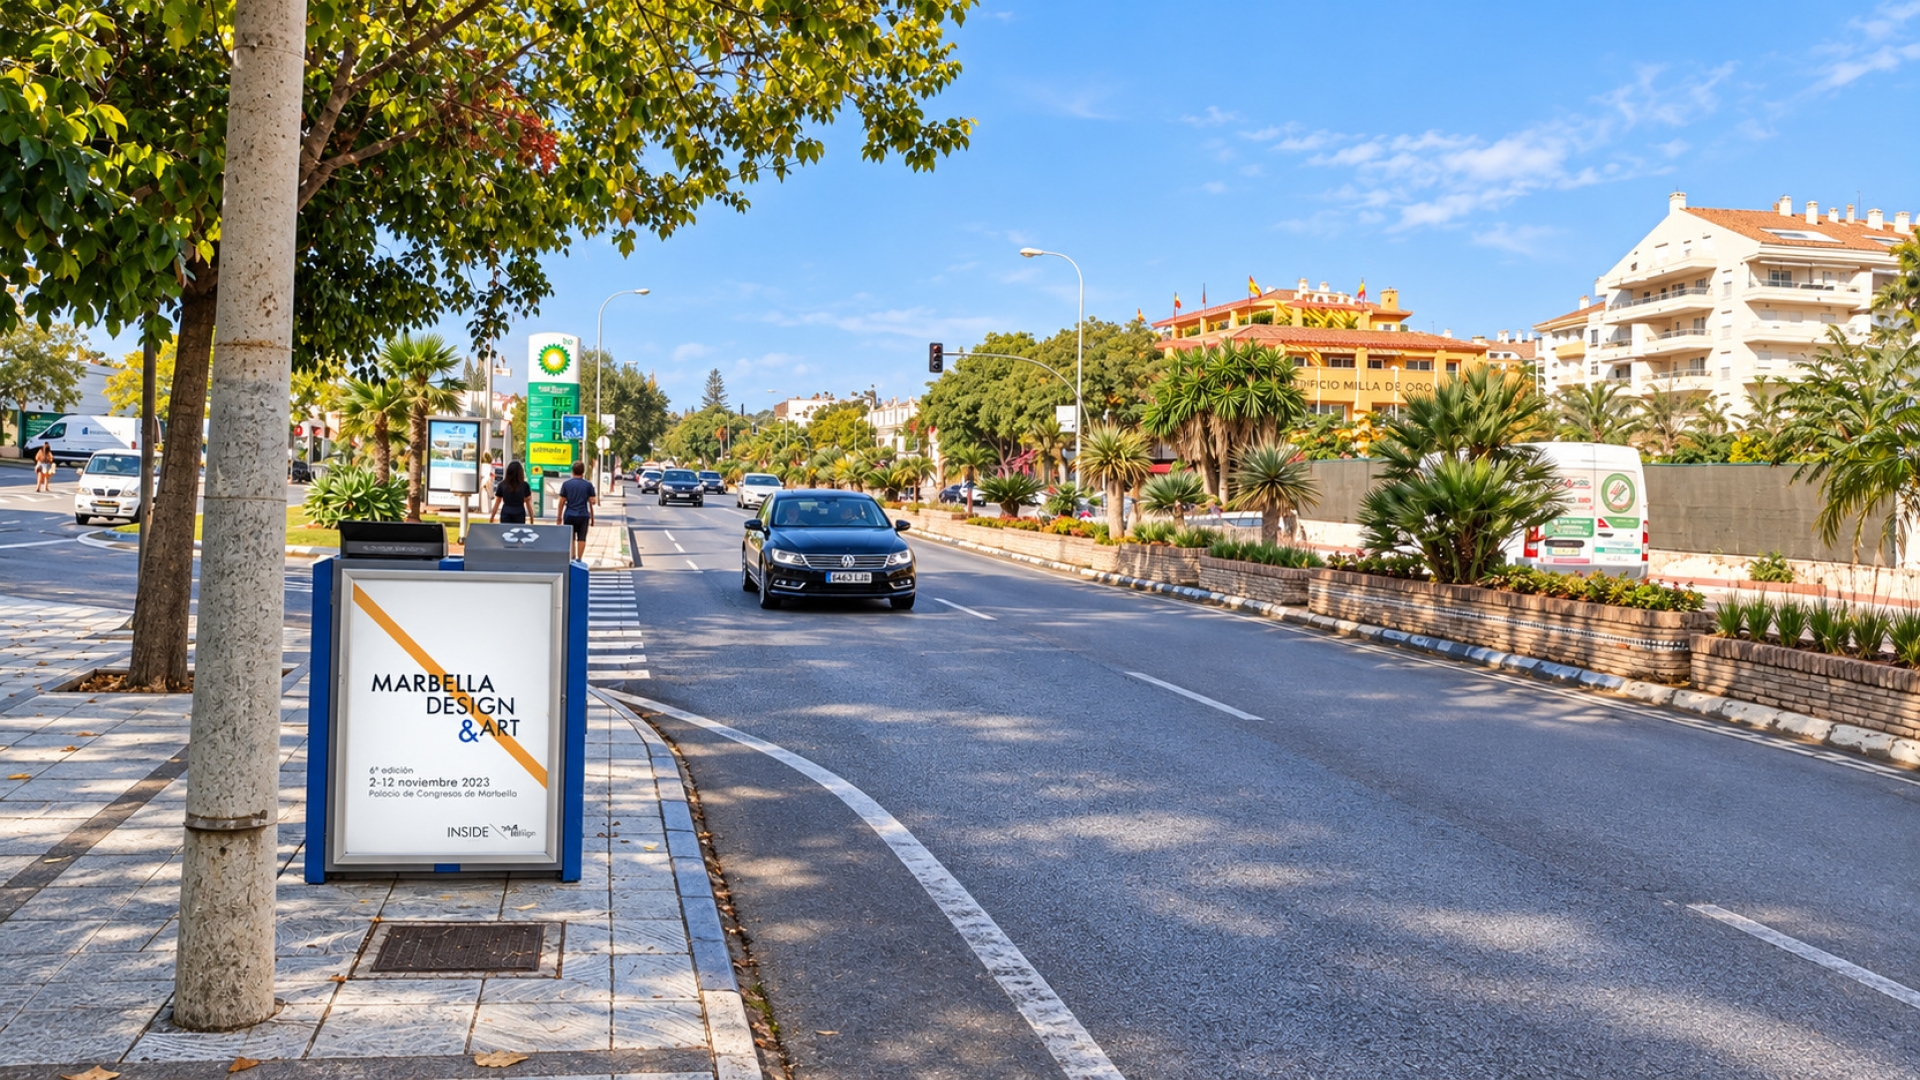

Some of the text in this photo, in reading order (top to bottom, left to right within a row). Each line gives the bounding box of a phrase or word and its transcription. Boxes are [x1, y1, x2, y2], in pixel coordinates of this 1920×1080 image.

[1344, 381, 1380, 391] MILLA
[1385, 382, 1401, 391] DE
[1405, 382, 1432, 392] ORO
[371, 674, 495, 692] MARBELLA
[426, 696, 514, 714] DESIGN
[369, 777, 490, 787] 2-12 noviembre 2023
[416, 790, 462, 799] Congresos
[447, 827, 489, 838] INSIDE
